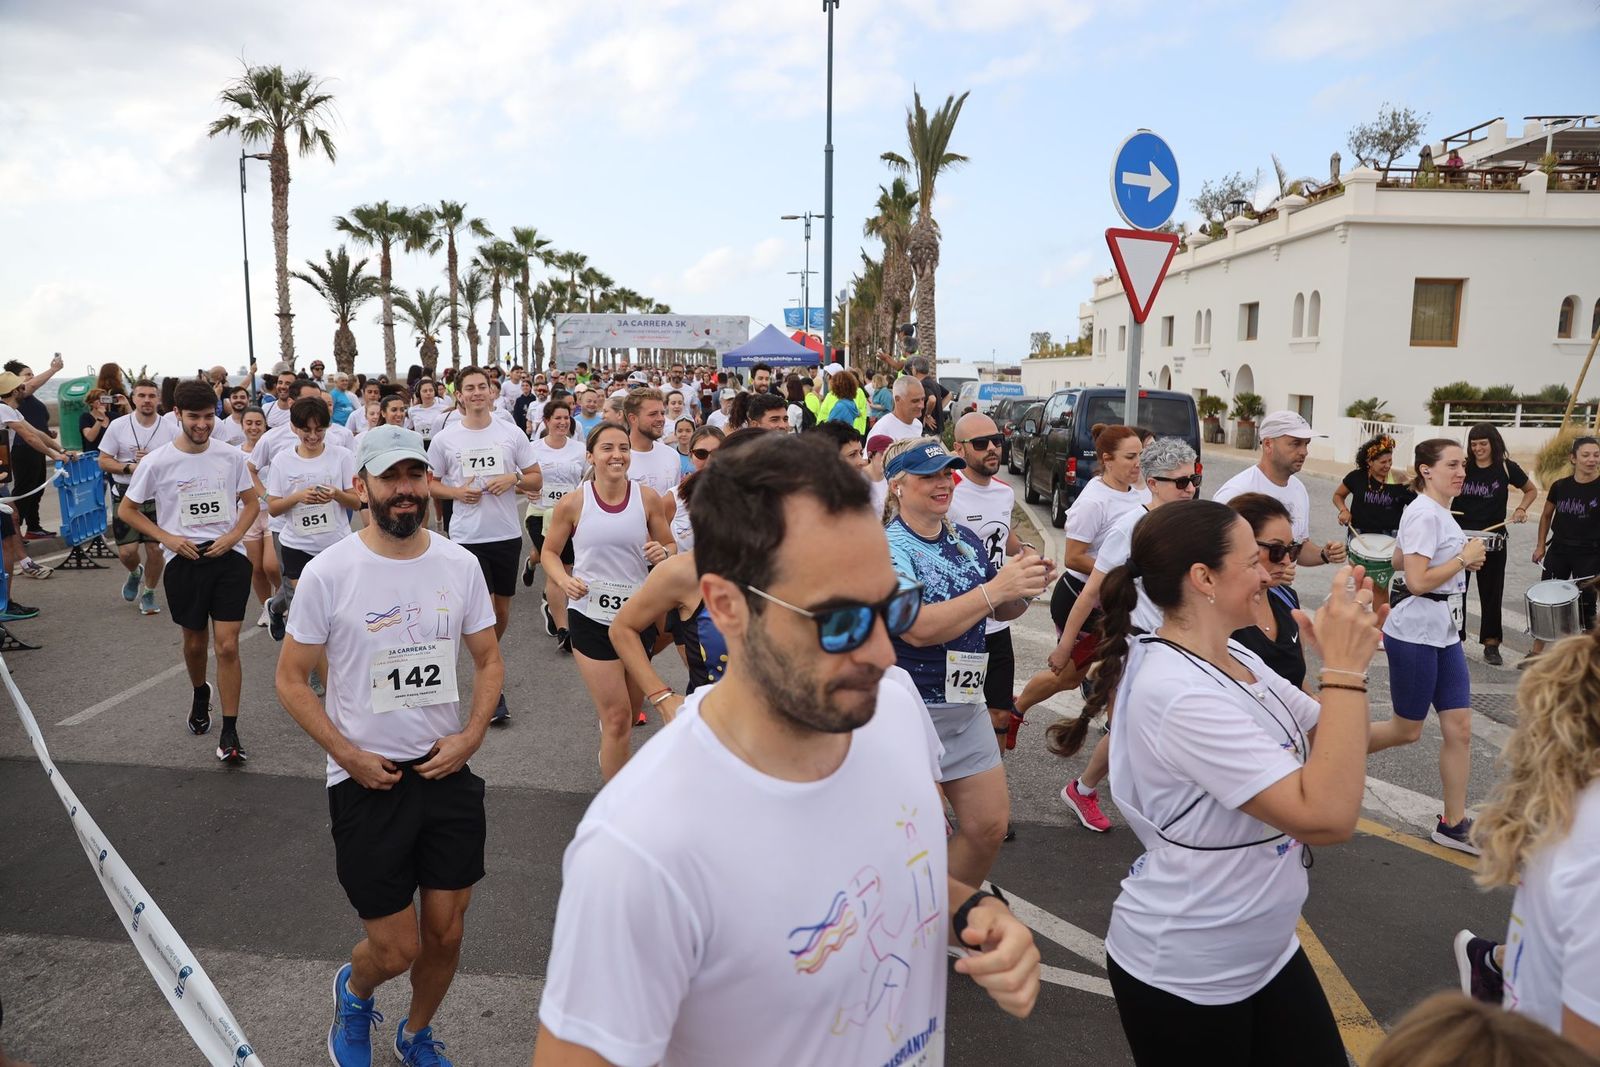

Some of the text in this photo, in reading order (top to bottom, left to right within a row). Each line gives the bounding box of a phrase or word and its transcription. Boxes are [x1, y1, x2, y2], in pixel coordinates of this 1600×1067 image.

[631, 319, 673, 327] CARRERA
[675, 320, 687, 328] 5K
[469, 456, 495, 468] 713
[548, 491, 568, 500] 49
[190, 501, 220, 515] 595
[302, 513, 327, 527] 851
[599, 594, 629, 610] 63
[397, 645, 427, 654] CARRERA
[387, 664, 442, 691] 142
